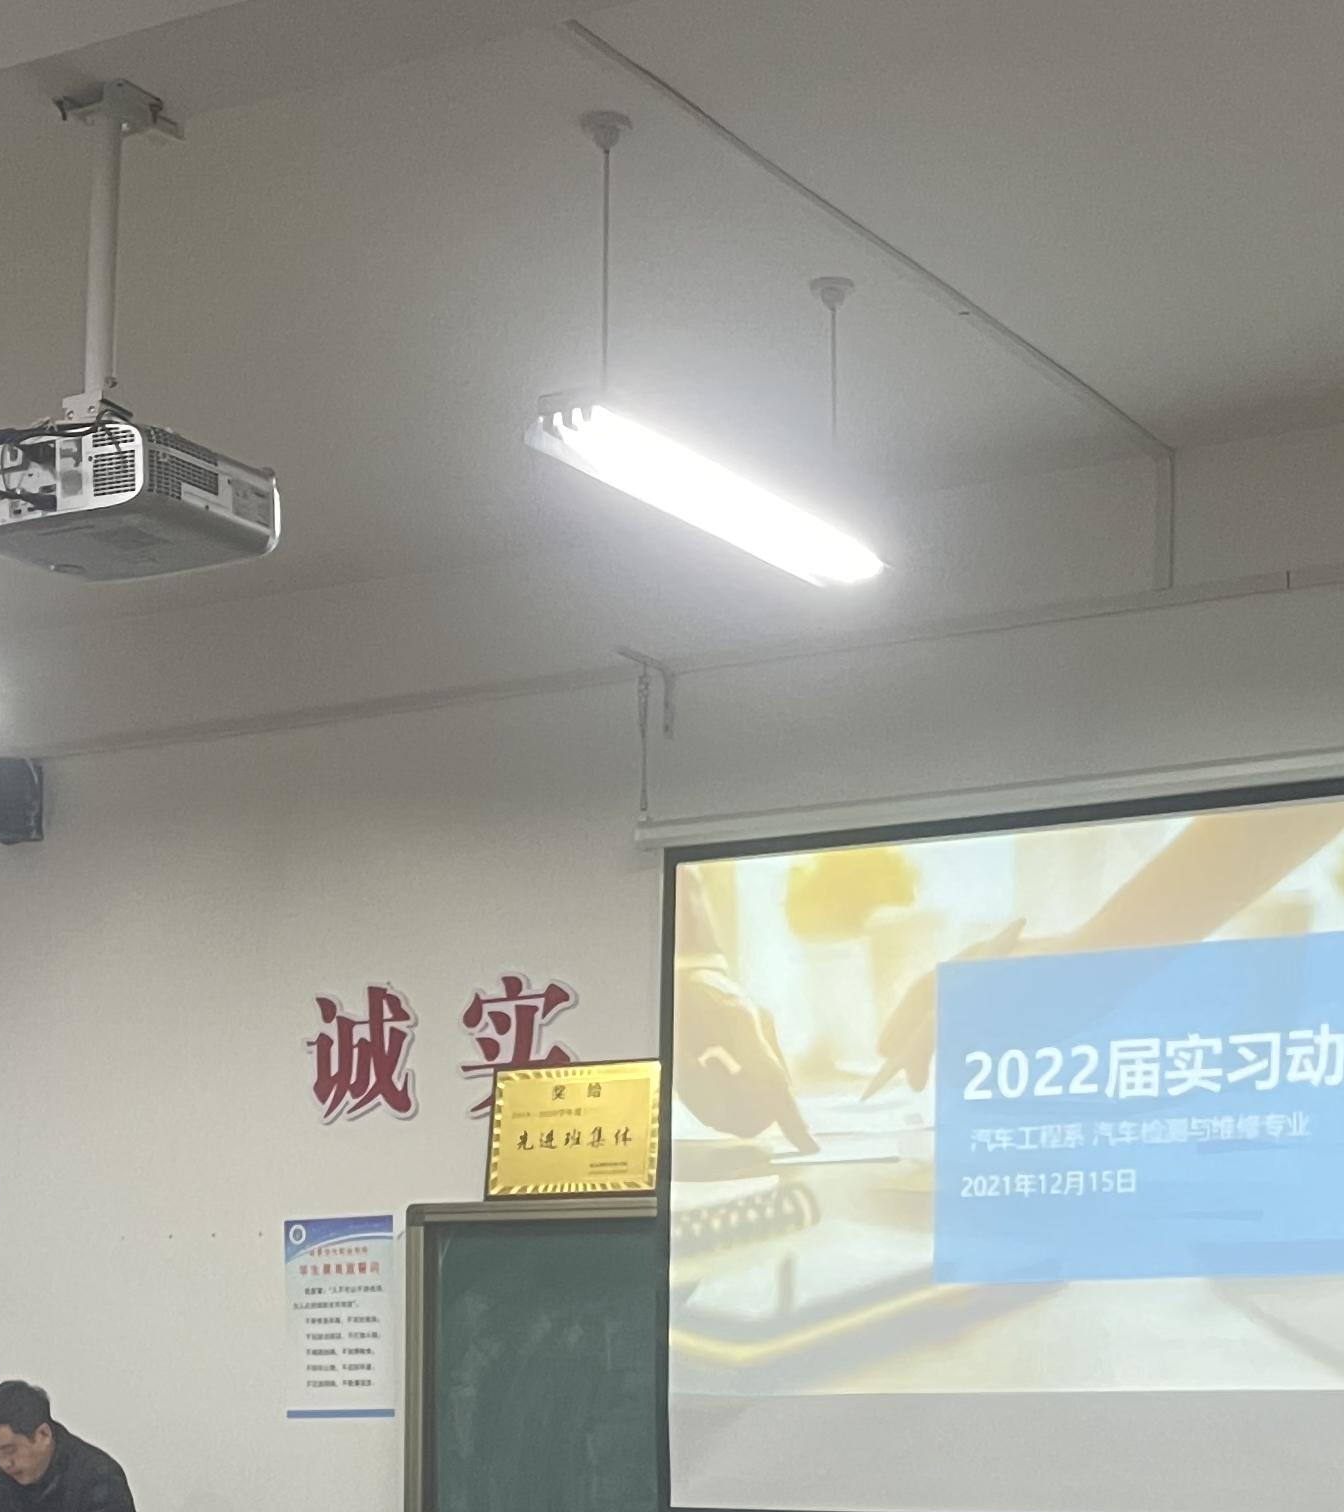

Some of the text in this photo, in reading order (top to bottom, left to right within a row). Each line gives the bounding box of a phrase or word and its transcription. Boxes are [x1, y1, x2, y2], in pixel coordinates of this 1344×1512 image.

[306, 975, 571, 1119] 诚实
[517, 1125, 633, 1151] 先进班集体
[970, 1122, 1084, 1152] 汽车工程系
[960, 1168, 1137, 1198] 2021年12月15日
